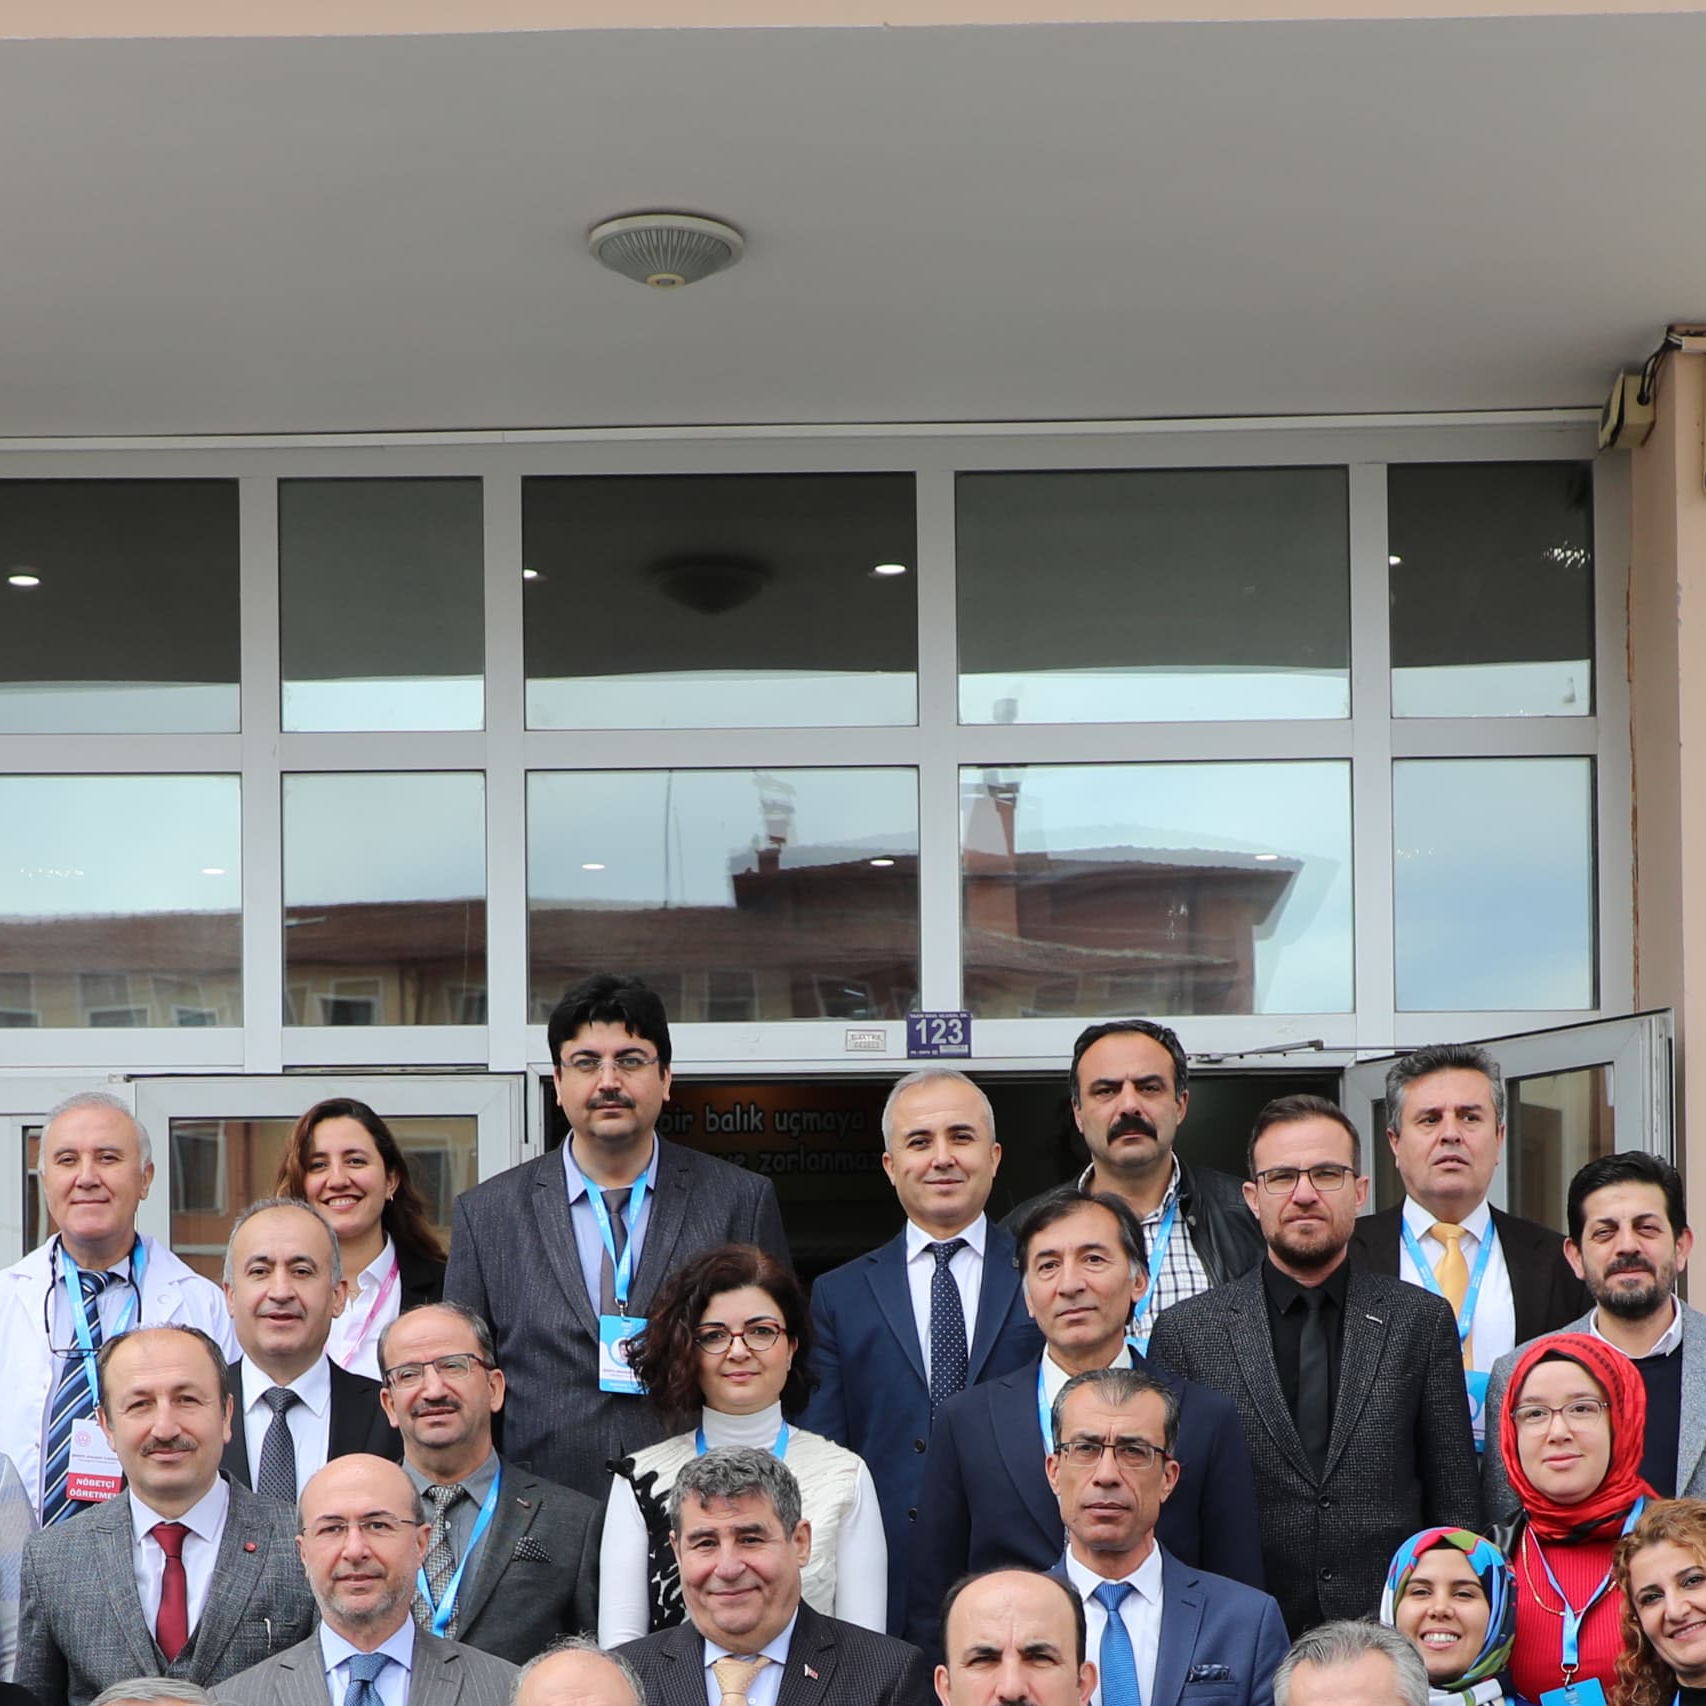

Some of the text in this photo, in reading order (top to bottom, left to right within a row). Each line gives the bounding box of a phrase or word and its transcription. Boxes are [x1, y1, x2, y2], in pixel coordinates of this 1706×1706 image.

[915, 1018, 964, 1045] 123
[705, 1104, 764, 1133] balık
[774, 1109, 866, 1139] uçmaya
[76, 1477, 115, 1489] NÖBETÇİ
